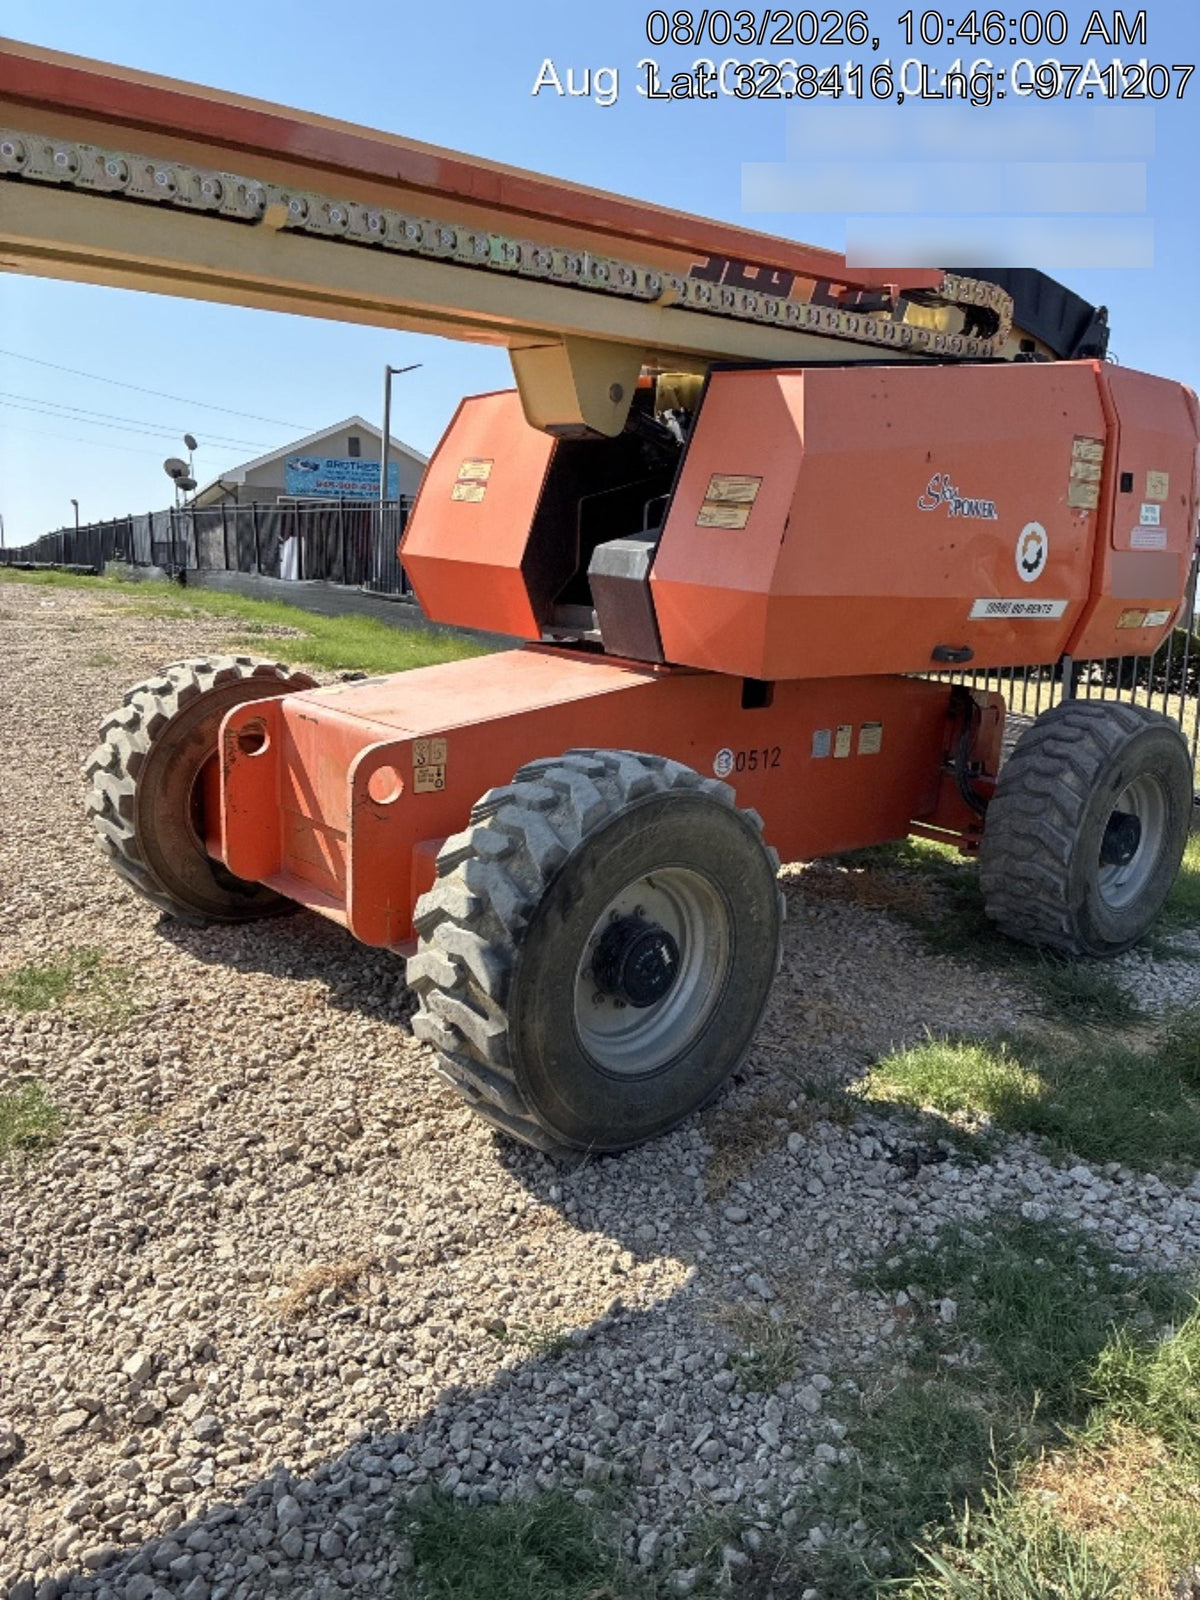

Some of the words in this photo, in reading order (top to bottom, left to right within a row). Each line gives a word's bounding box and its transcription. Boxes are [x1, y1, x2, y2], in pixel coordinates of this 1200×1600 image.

[917, 472, 960, 516] Sky
[950, 498, 998, 520] POWER
[735, 746, 782, 772] 0512
